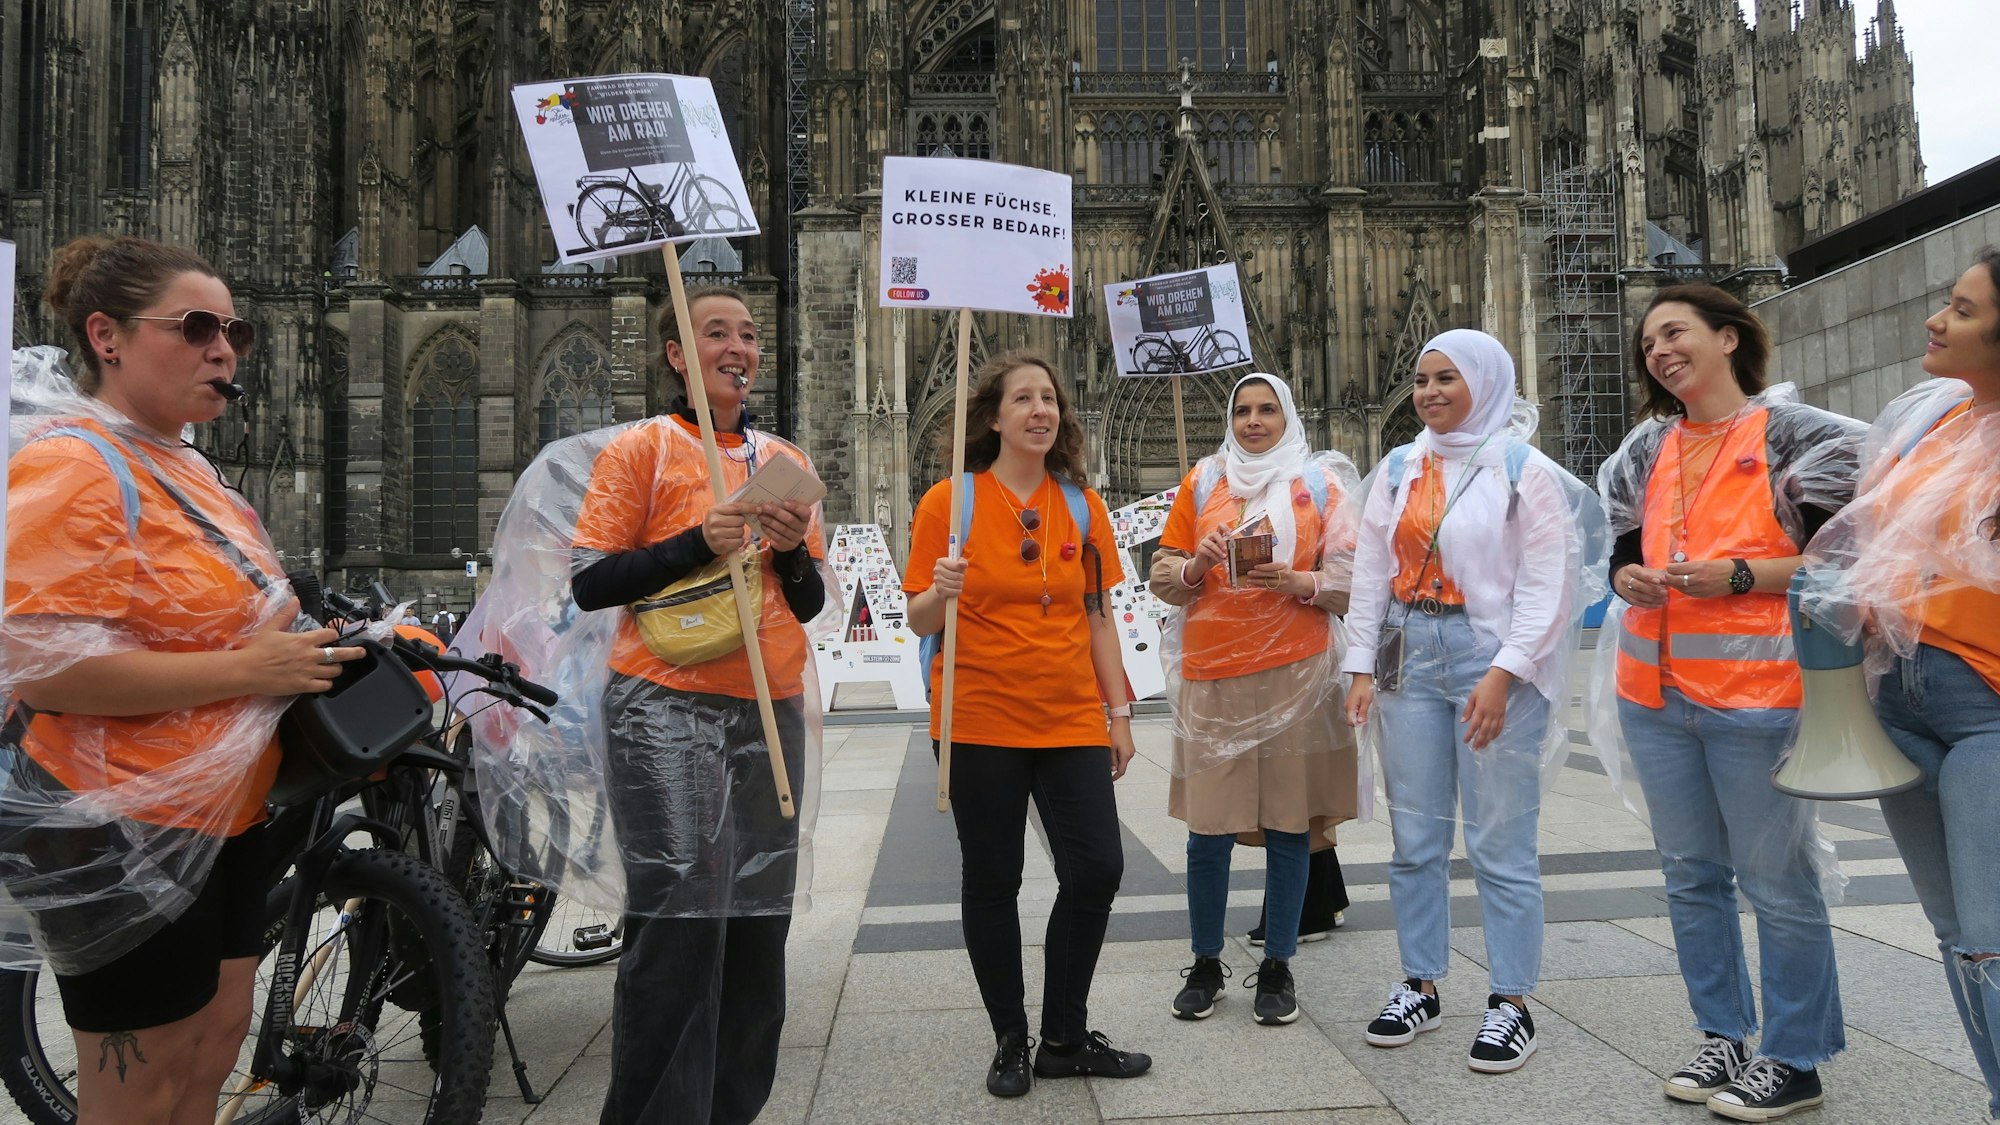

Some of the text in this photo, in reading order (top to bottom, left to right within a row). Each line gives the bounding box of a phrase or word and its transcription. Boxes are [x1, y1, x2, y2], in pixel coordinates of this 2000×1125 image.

[586, 104, 617, 125] WIR
[618, 101, 674, 121] DREHEN
[608, 120, 668, 143] AM RAD!
[905, 189, 1057, 218] KLEINE FÜCHSE,
[892, 212, 1066, 240] GROSSER BEDARF!
[892, 290, 925, 299] FOLLOW US
[1146, 293, 1165, 307] WIR
[1167, 286, 1204, 304] DREHEN
[1157, 300, 1198, 317] AM RAD!
[442, 799, 455, 821] 6061
